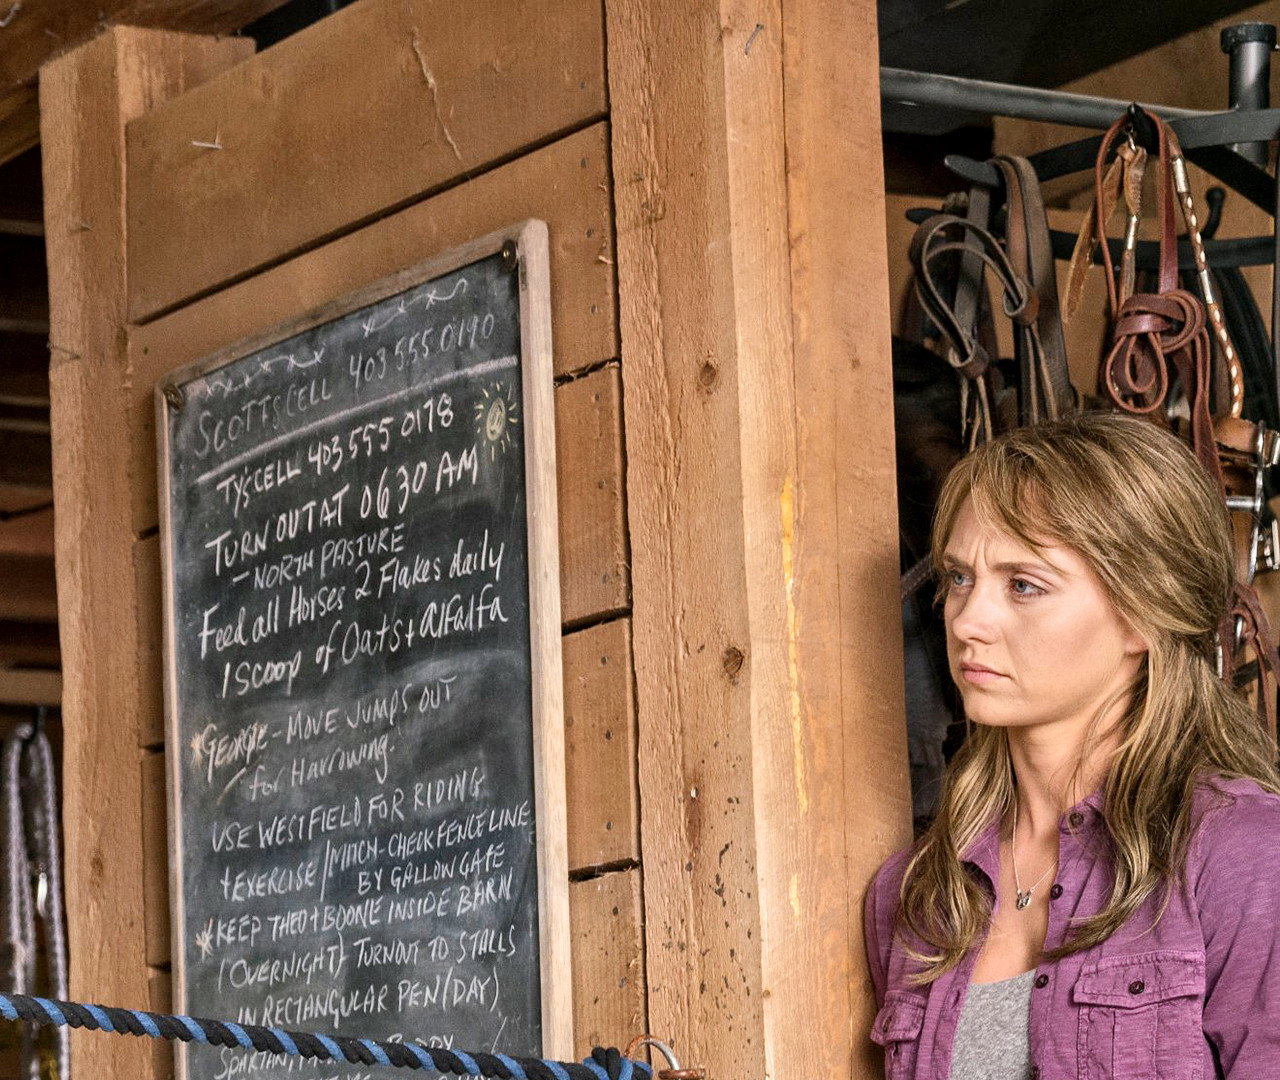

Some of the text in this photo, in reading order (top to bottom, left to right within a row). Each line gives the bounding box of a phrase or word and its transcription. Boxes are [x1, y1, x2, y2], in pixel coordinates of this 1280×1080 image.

[349, 347, 386, 388] 403
[395, 328, 433, 371] 555
[254, 459, 301, 492] CELL
[308, 435, 342, 475] 403
[349, 417, 394, 458] 555
[254, 549, 313, 590] NORTH
[320, 523, 404, 580] PASTURE
[198, 529, 504, 660] Feed all Horses 2 Flakes daily
[316, 620, 341, 674] of
[342, 613, 402, 664] Oats
[287, 708, 339, 745] MOVE
[419, 675, 457, 713] OUT
[212, 821, 253, 853] USE
[368, 788, 404, 825] FOR
[414, 766, 485, 812] RIDING
[217, 914, 262, 948] KEEP
[388, 887, 451, 924] INSIDE
[457, 867, 513, 917] BARN
[232, 860, 317, 902] EXERCISE
[358, 868, 382, 895] BY
[428, 935, 449, 963] TO
[457, 925, 515, 964] STALLS
[238, 1006, 257, 1027] IN
[262, 984, 388, 1029] RECTANGULAR
[398, 974, 440, 1012] PEN
